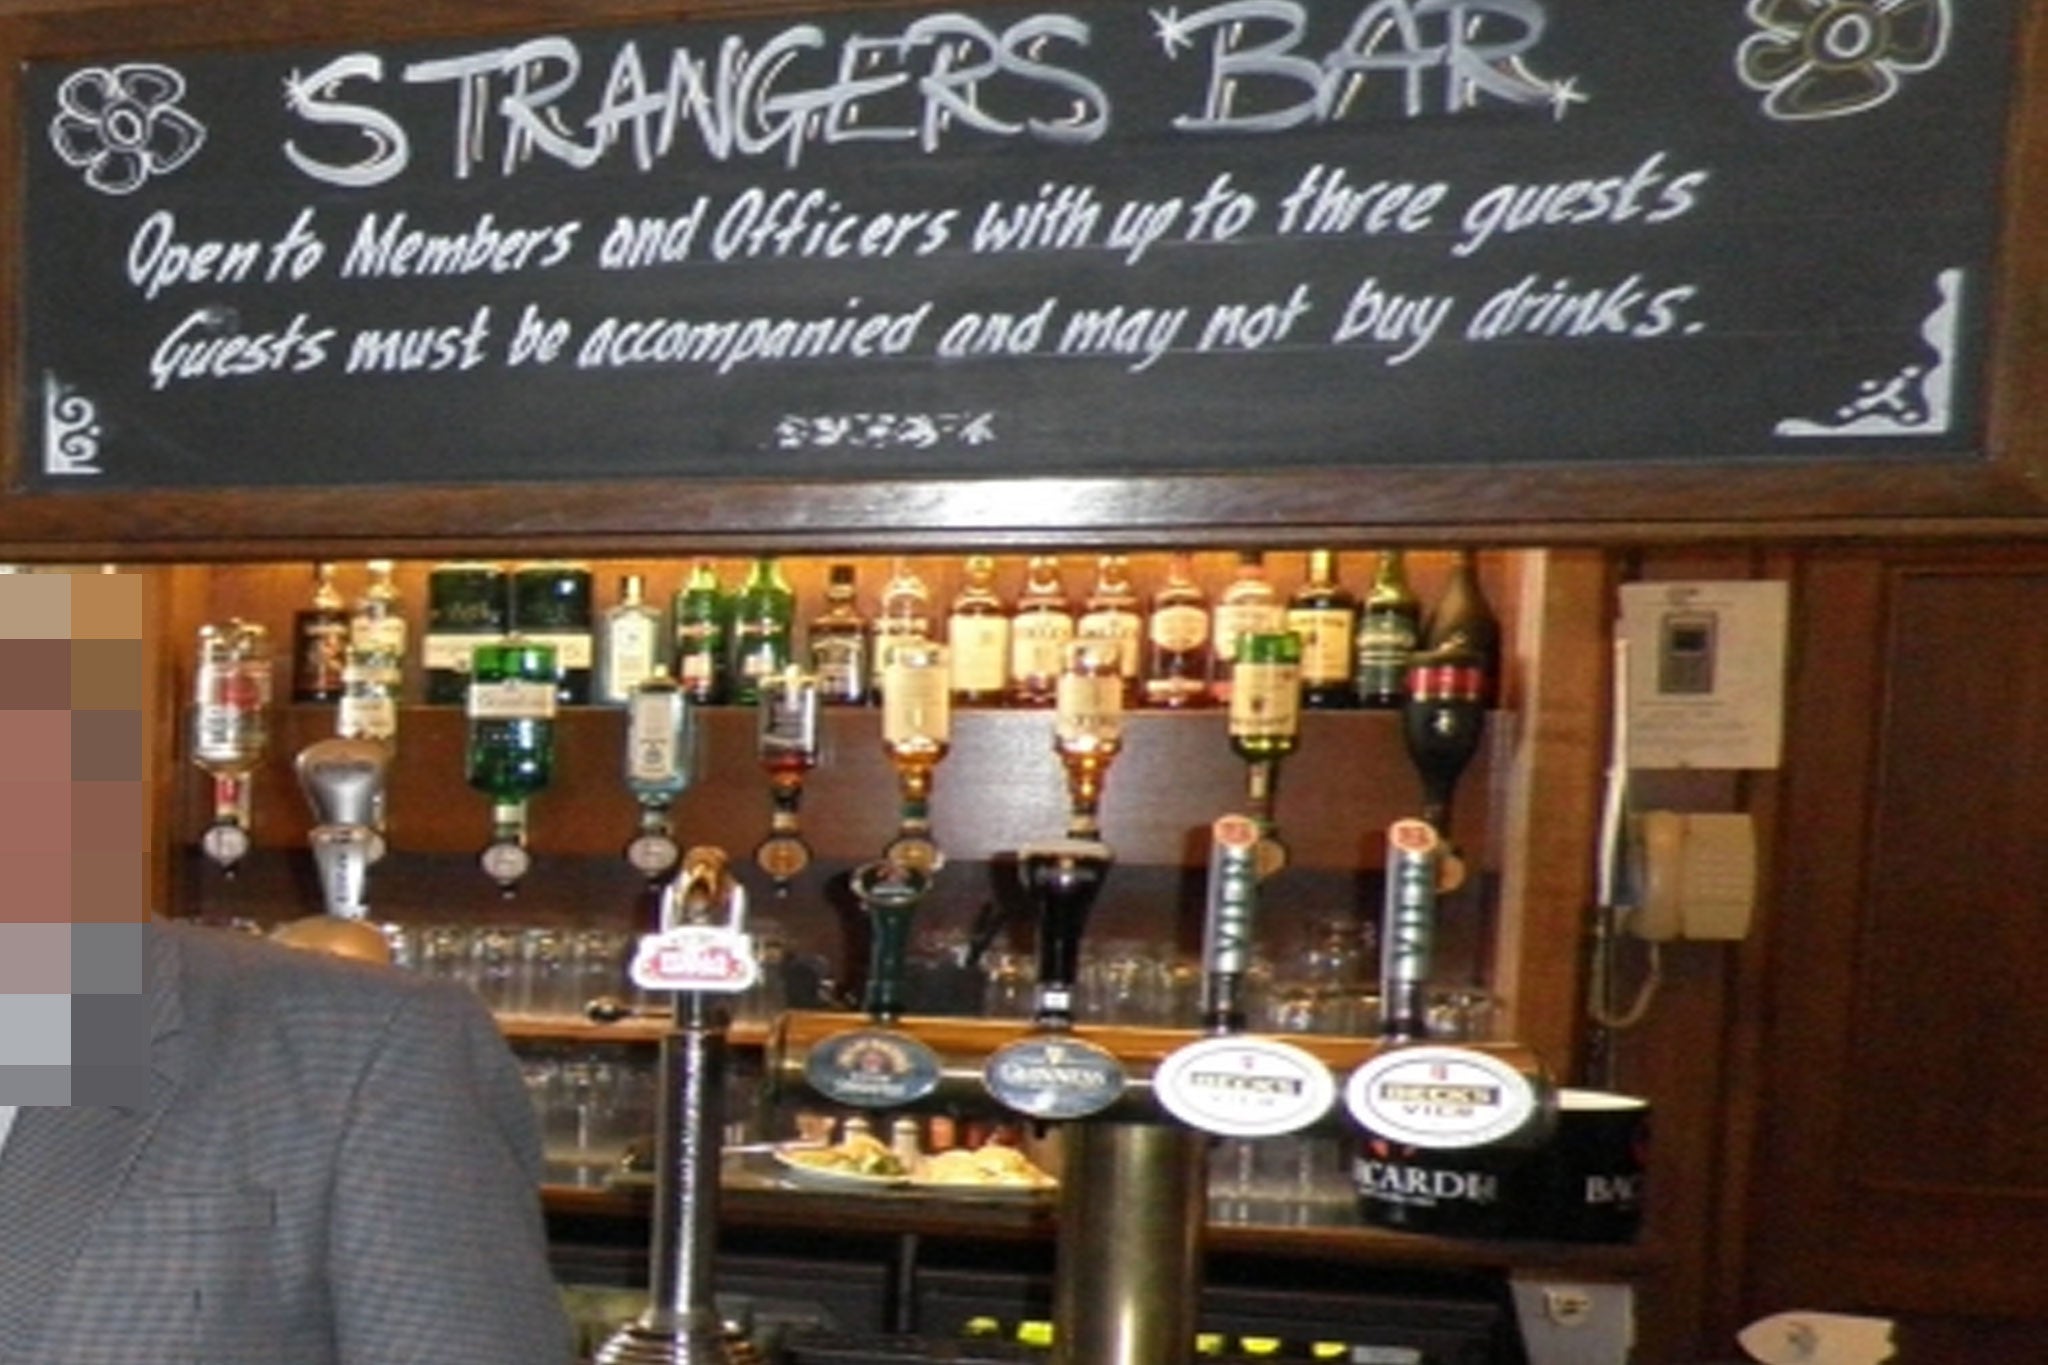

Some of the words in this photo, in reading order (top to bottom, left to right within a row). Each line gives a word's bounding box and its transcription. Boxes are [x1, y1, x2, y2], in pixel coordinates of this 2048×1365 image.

[283, 13, 1109, 187] STRANGERS
[1170, 0, 1565, 131] BAR
[127, 210, 261, 299] Open
[265, 207, 326, 282] to
[340, 211, 581, 279] Members
[598, 195, 707, 270] and
[711, 186, 960, 263] Officers
[971, 181, 1102, 254] with
[1105, 197, 1183, 266] up
[1184, 172, 1258, 243] to
[1277, 163, 1450, 236] three
[1450, 151, 1710, 258] guests
[149, 309, 337, 391] Guests
[345, 305, 491, 374] must
[506, 303, 571, 367] be
[576, 296, 933, 375] accompanied
[936, 296, 1057, 357] and
[1056, 305, 1188, 374] may
[1194, 283, 1312, 352] not
[1332, 276, 1454, 366] buy
[1465, 273, 1707, 342] drinks.
